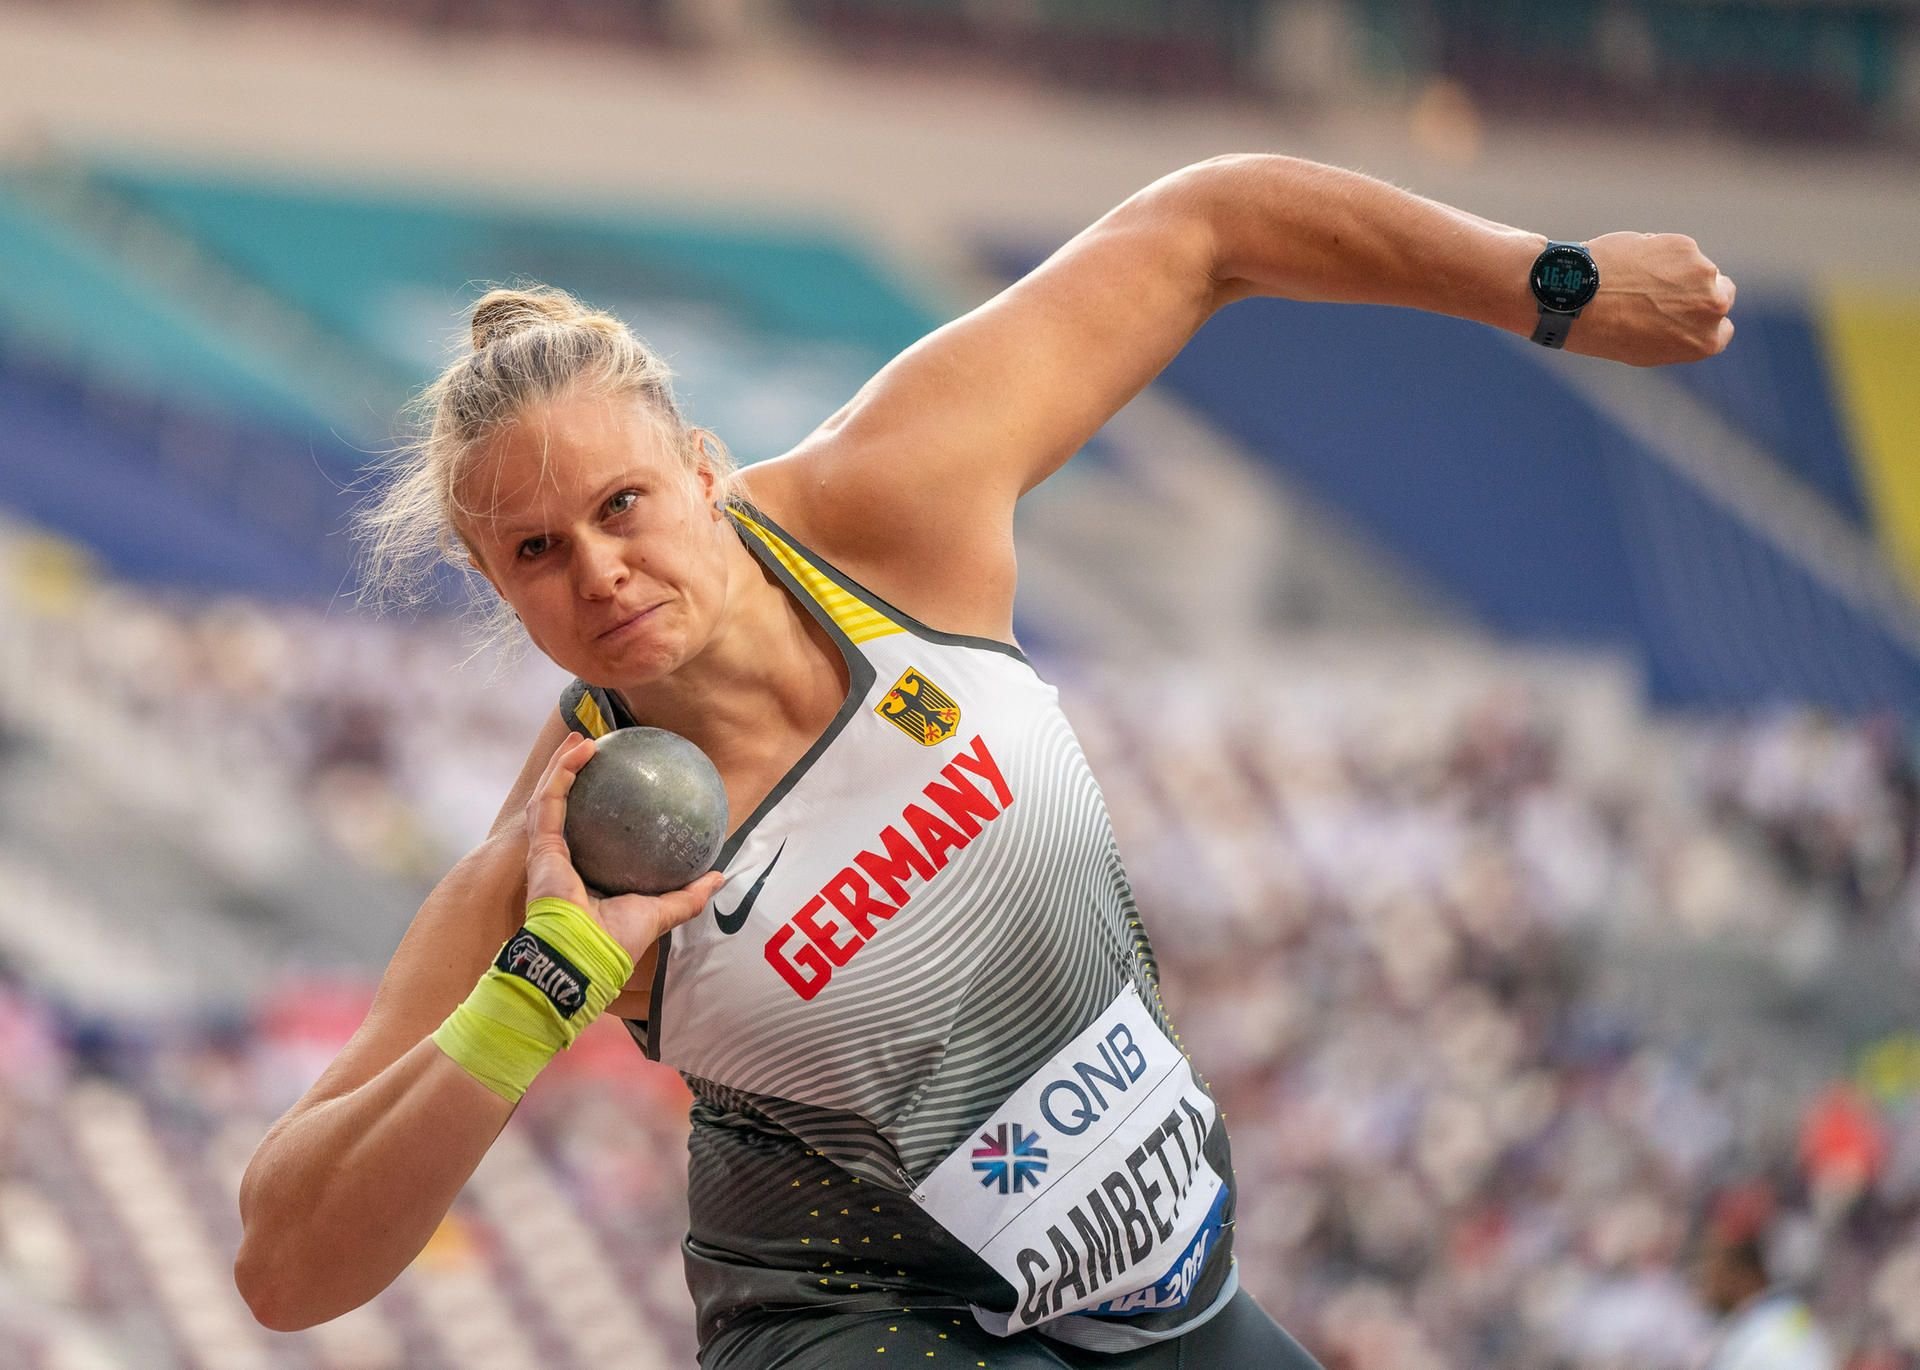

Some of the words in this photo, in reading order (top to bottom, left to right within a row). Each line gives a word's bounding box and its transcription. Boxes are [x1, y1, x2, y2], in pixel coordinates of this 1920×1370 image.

[1542, 266, 1582, 290] 16:48
[764, 734, 1014, 1001] GERMANY
[526, 952, 580, 1006] BLITZ
[1039, 1023, 1147, 1136] QNB
[1016, 1096, 1207, 1325] GAMBETTA
